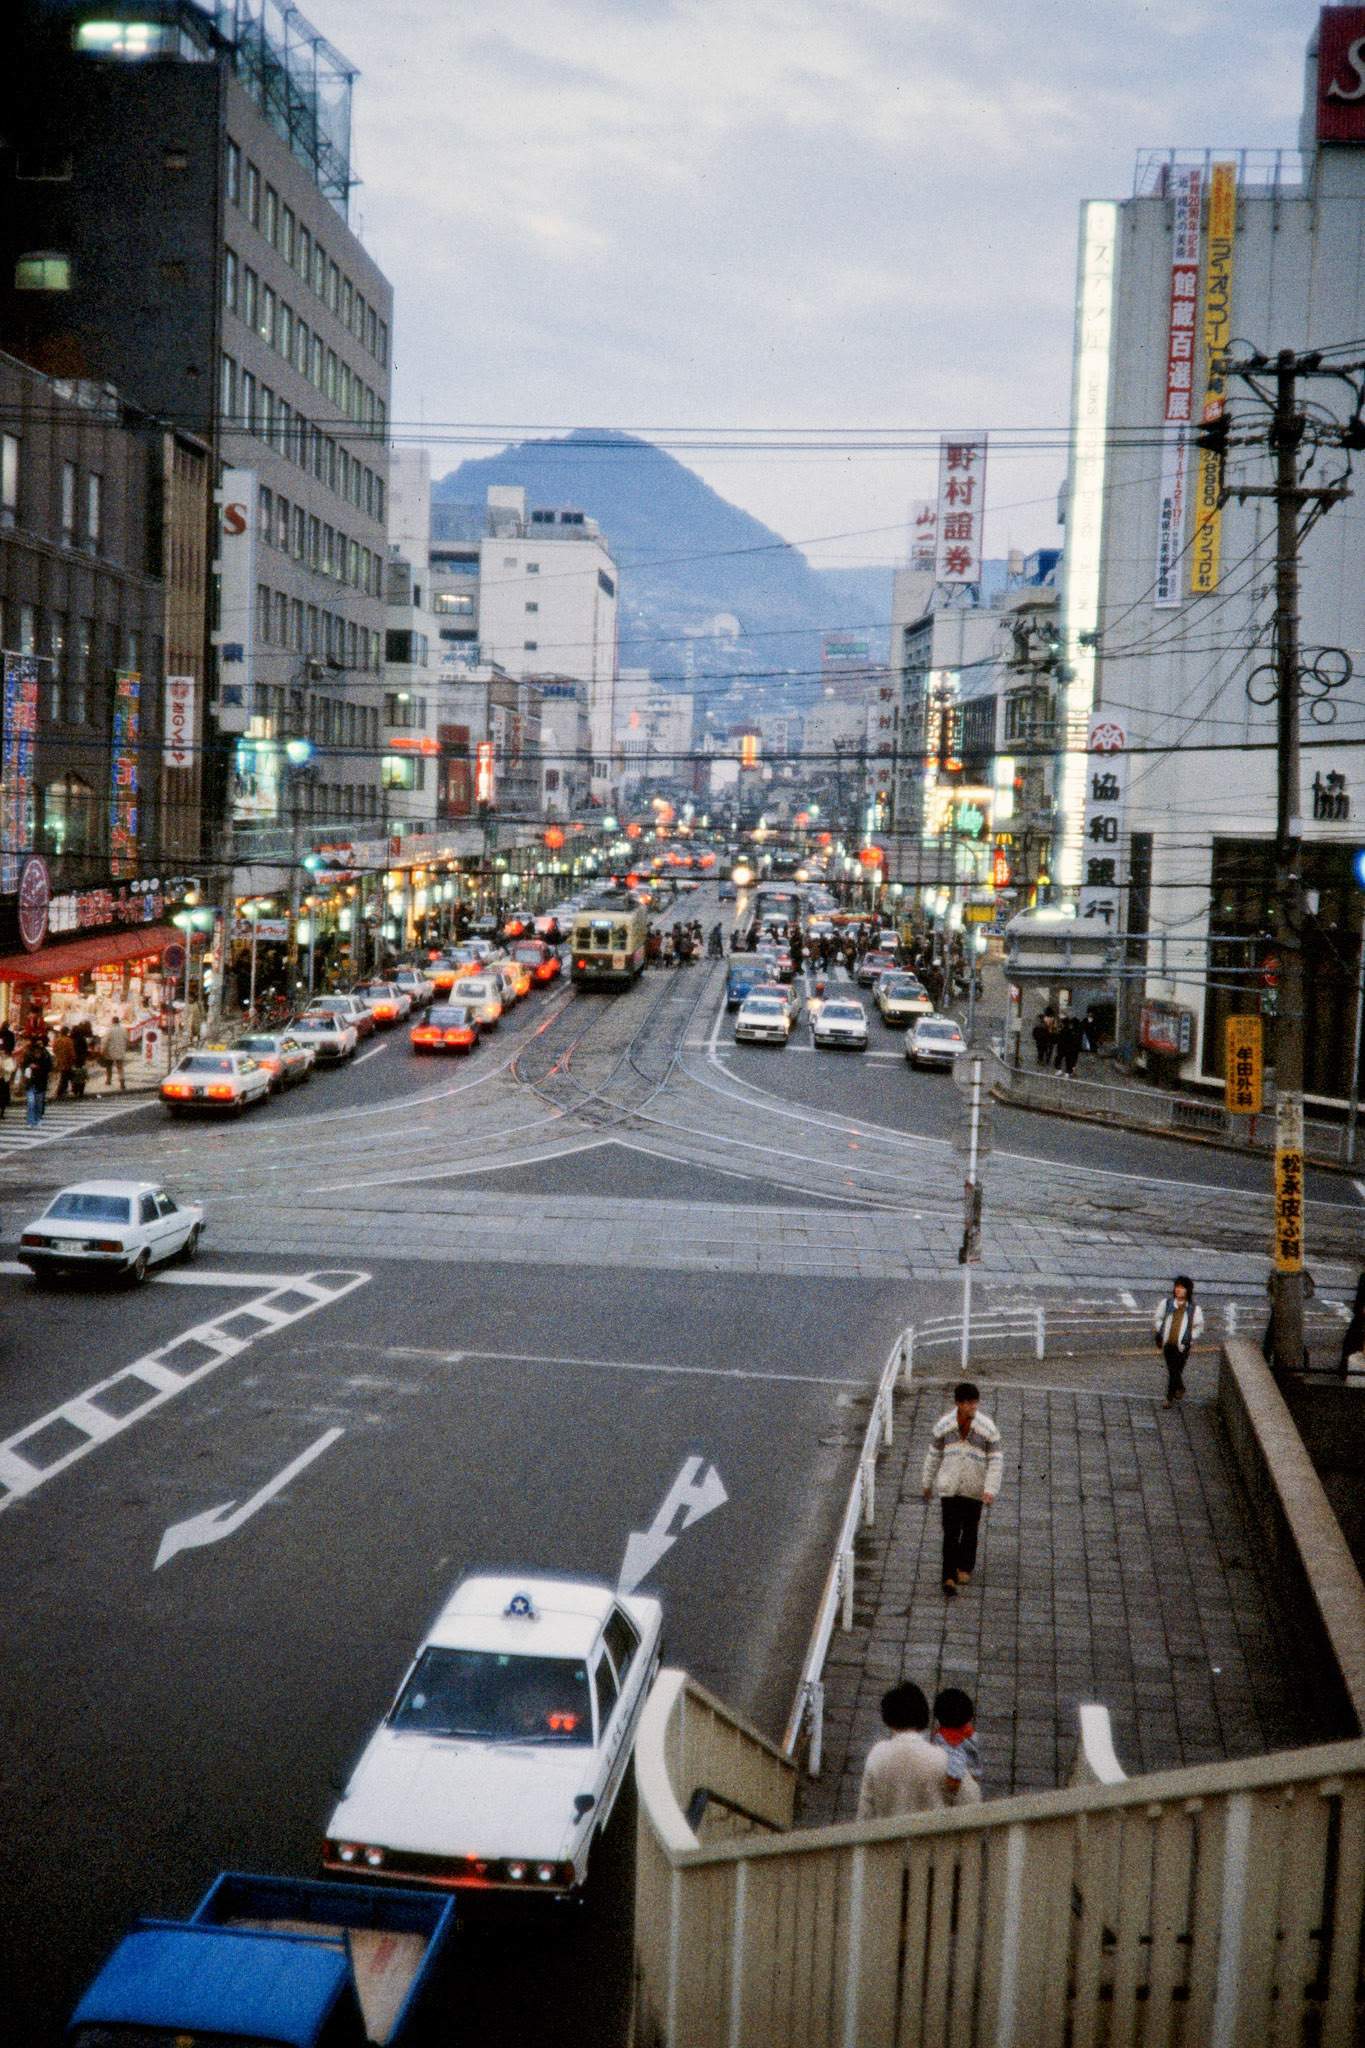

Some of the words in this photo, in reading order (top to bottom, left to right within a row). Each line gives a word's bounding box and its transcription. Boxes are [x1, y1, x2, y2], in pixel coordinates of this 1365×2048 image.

[1167, 271, 1196, 418] 館蔵百選展
[224, 503, 248, 535] S
[1312, 769, 1351, 820] 協
[1084, 771, 1120, 925] 協和銀行
[1236, 1046, 1253, 1106] 牟田外科
[1281, 1154, 1301, 1260] 松永皮ふ科
